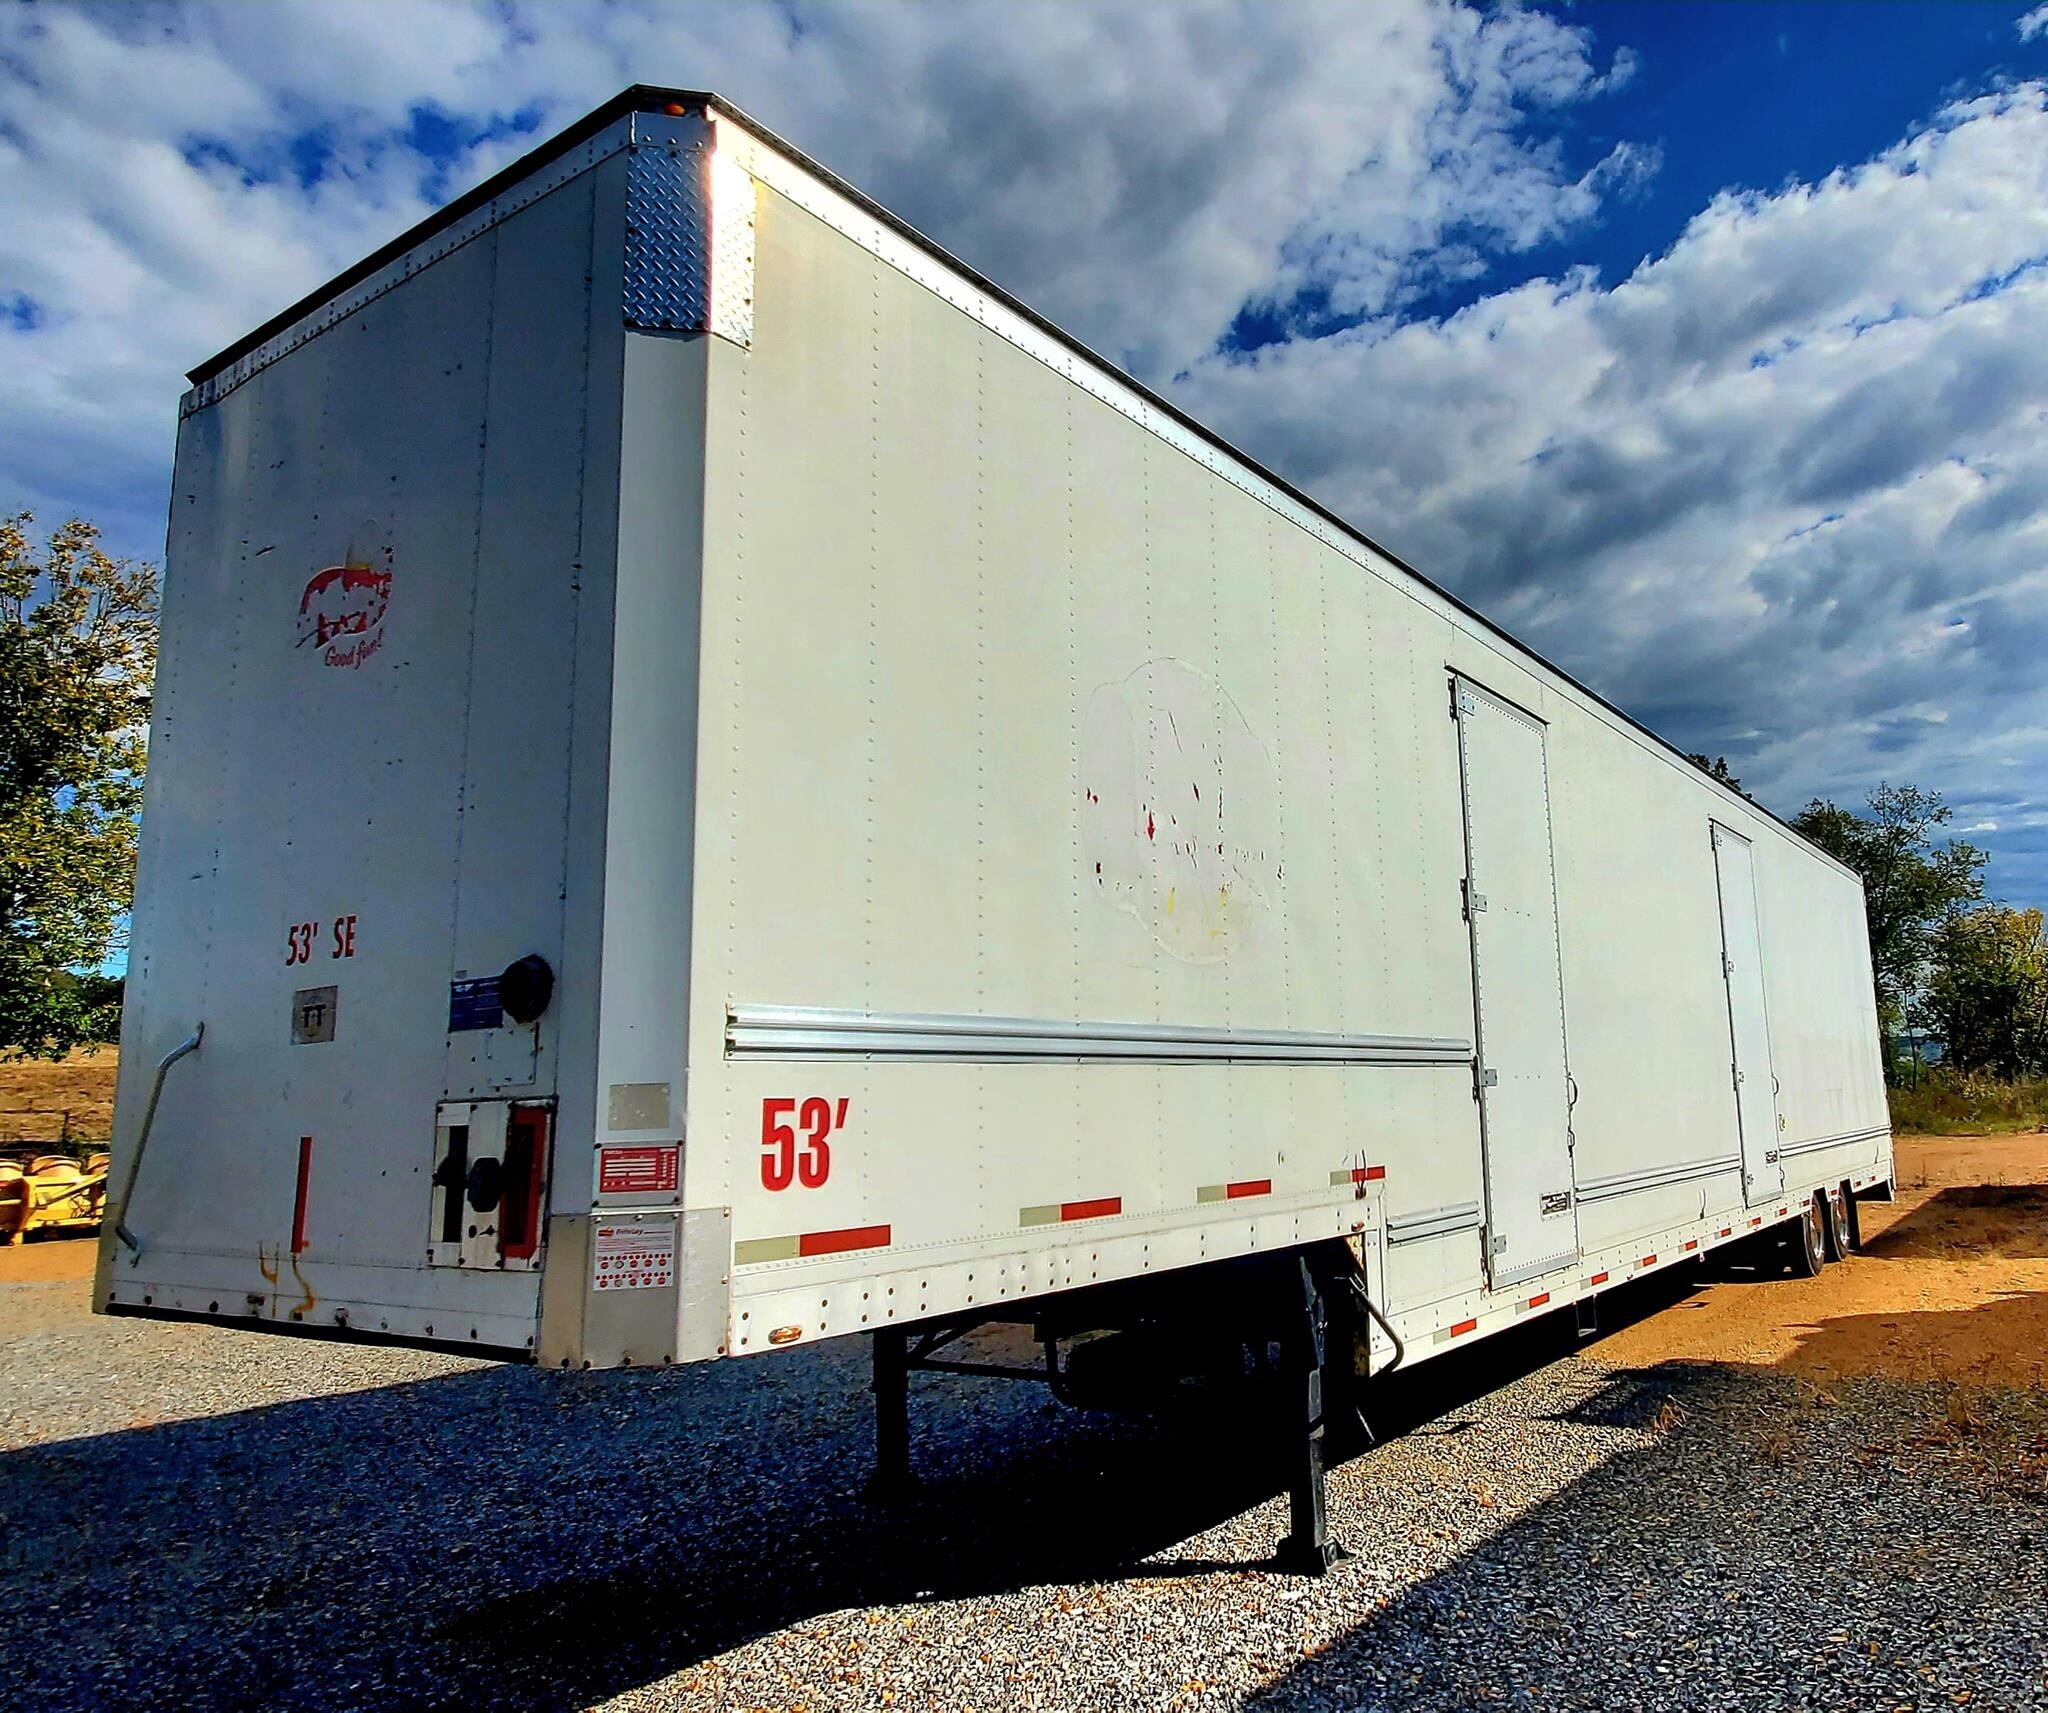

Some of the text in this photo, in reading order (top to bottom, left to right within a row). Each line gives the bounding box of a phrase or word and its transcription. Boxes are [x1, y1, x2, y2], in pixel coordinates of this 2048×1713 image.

[285, 915, 357, 967] 53' SE
[761, 1097, 850, 1192] 53'
